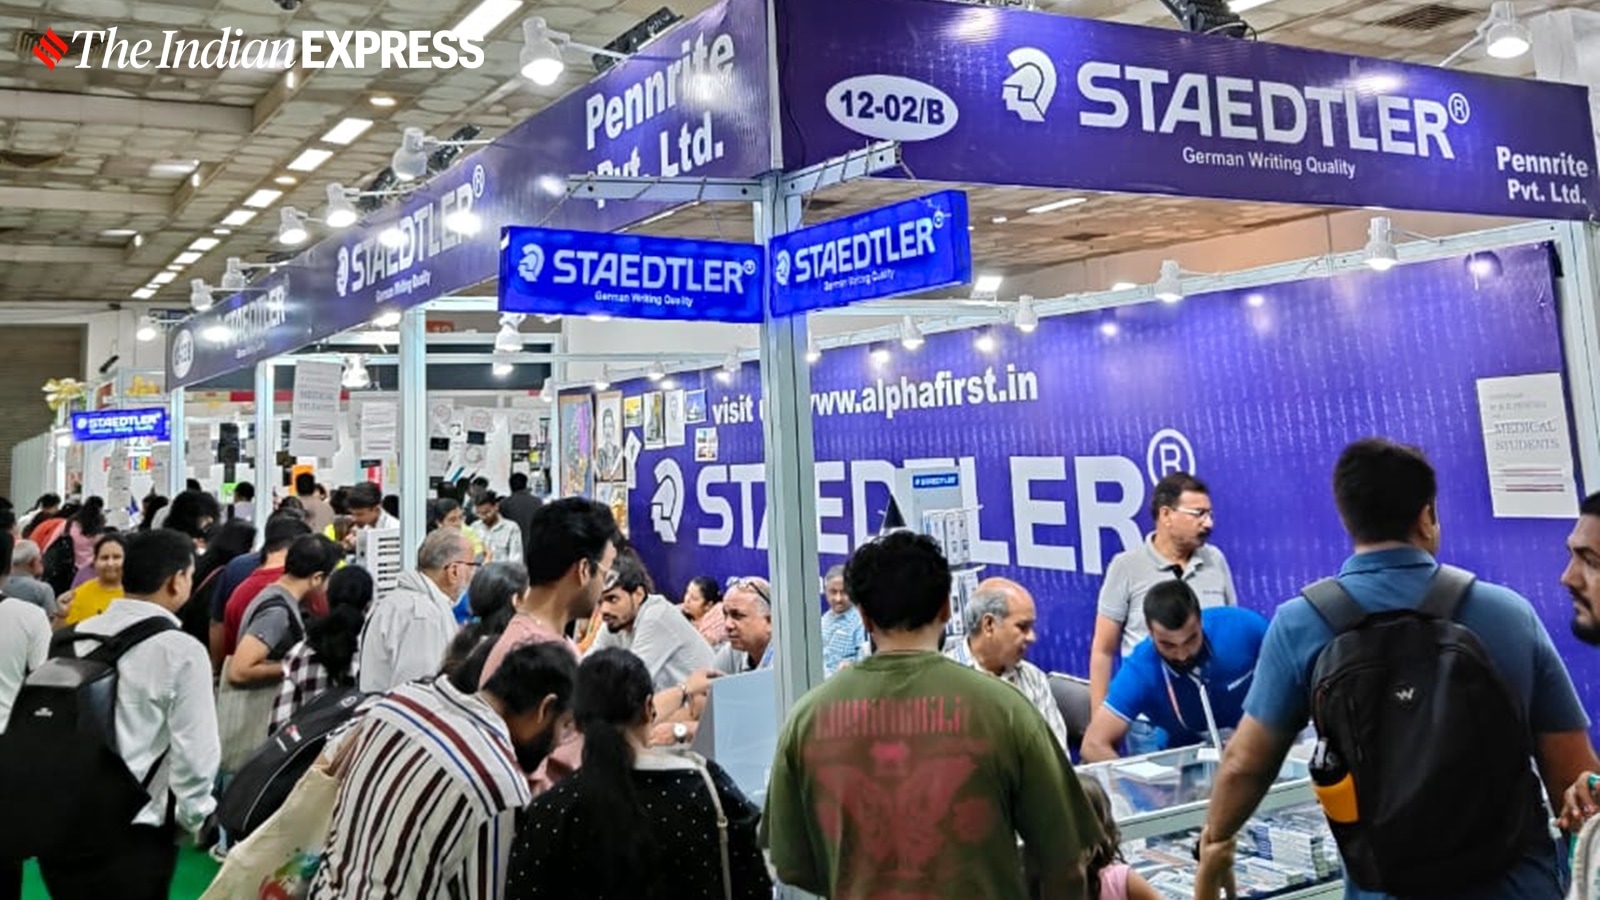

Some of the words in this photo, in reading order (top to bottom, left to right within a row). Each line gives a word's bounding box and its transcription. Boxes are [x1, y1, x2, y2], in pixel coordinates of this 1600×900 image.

[586, 31, 735, 150] Pennrite
[840, 89, 945, 126] 12-02/B
[660, 111, 723, 177] Ltd.
[1182, 147, 1244, 168] German
[1249, 152, 1302, 175] Writing
[1306, 156, 1356, 179] Quality
[1496, 146, 1589, 177] Pennrite
[1507, 178, 1545, 202] Pvt.
[1550, 181, 1587, 204] Ltd.
[712, 395, 753, 425] visit
